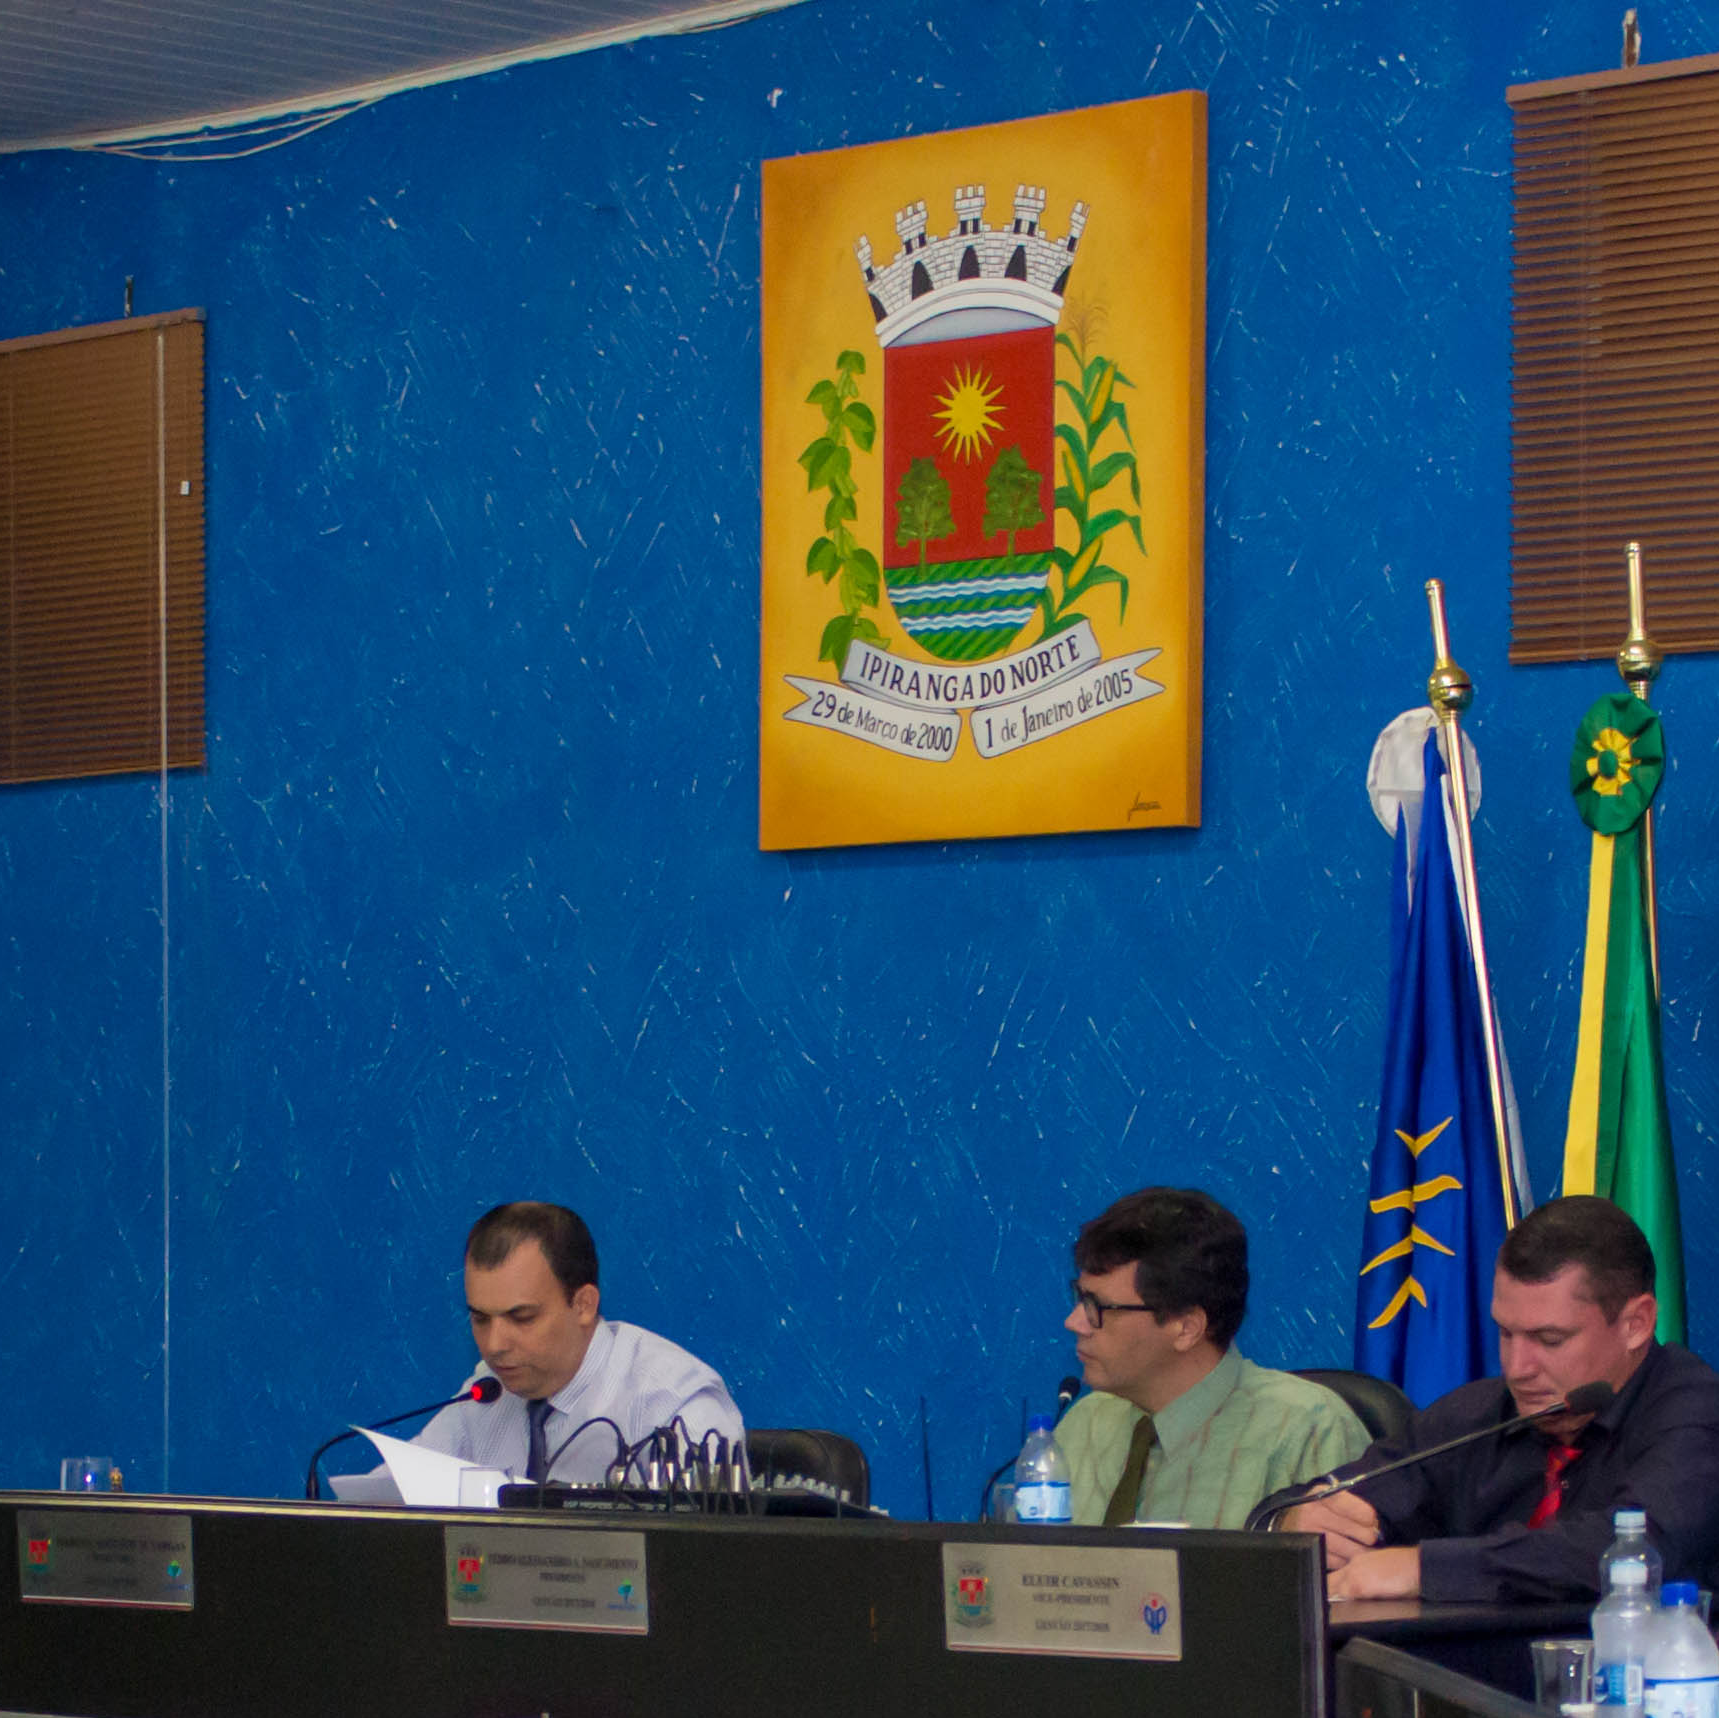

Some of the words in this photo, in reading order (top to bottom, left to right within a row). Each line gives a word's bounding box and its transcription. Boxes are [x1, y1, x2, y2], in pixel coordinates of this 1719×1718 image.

[860, 650, 975, 702] IPIRANGA
[981, 666, 1006, 695] DO
[1010, 633, 1081, 688] NORTE
[811, 690, 837, 718] 29
[837, 701, 855, 725] de
[855, 710, 898, 742] Março
[900, 721, 917, 747] de
[917, 723, 953, 753] 2000
[985, 717, 994, 749] 1
[1001, 714, 1021, 739] de
[1021, 697, 1075, 743] Janeiro
[1077, 689, 1095, 713] de
[1093, 668, 1134, 707] 2005
